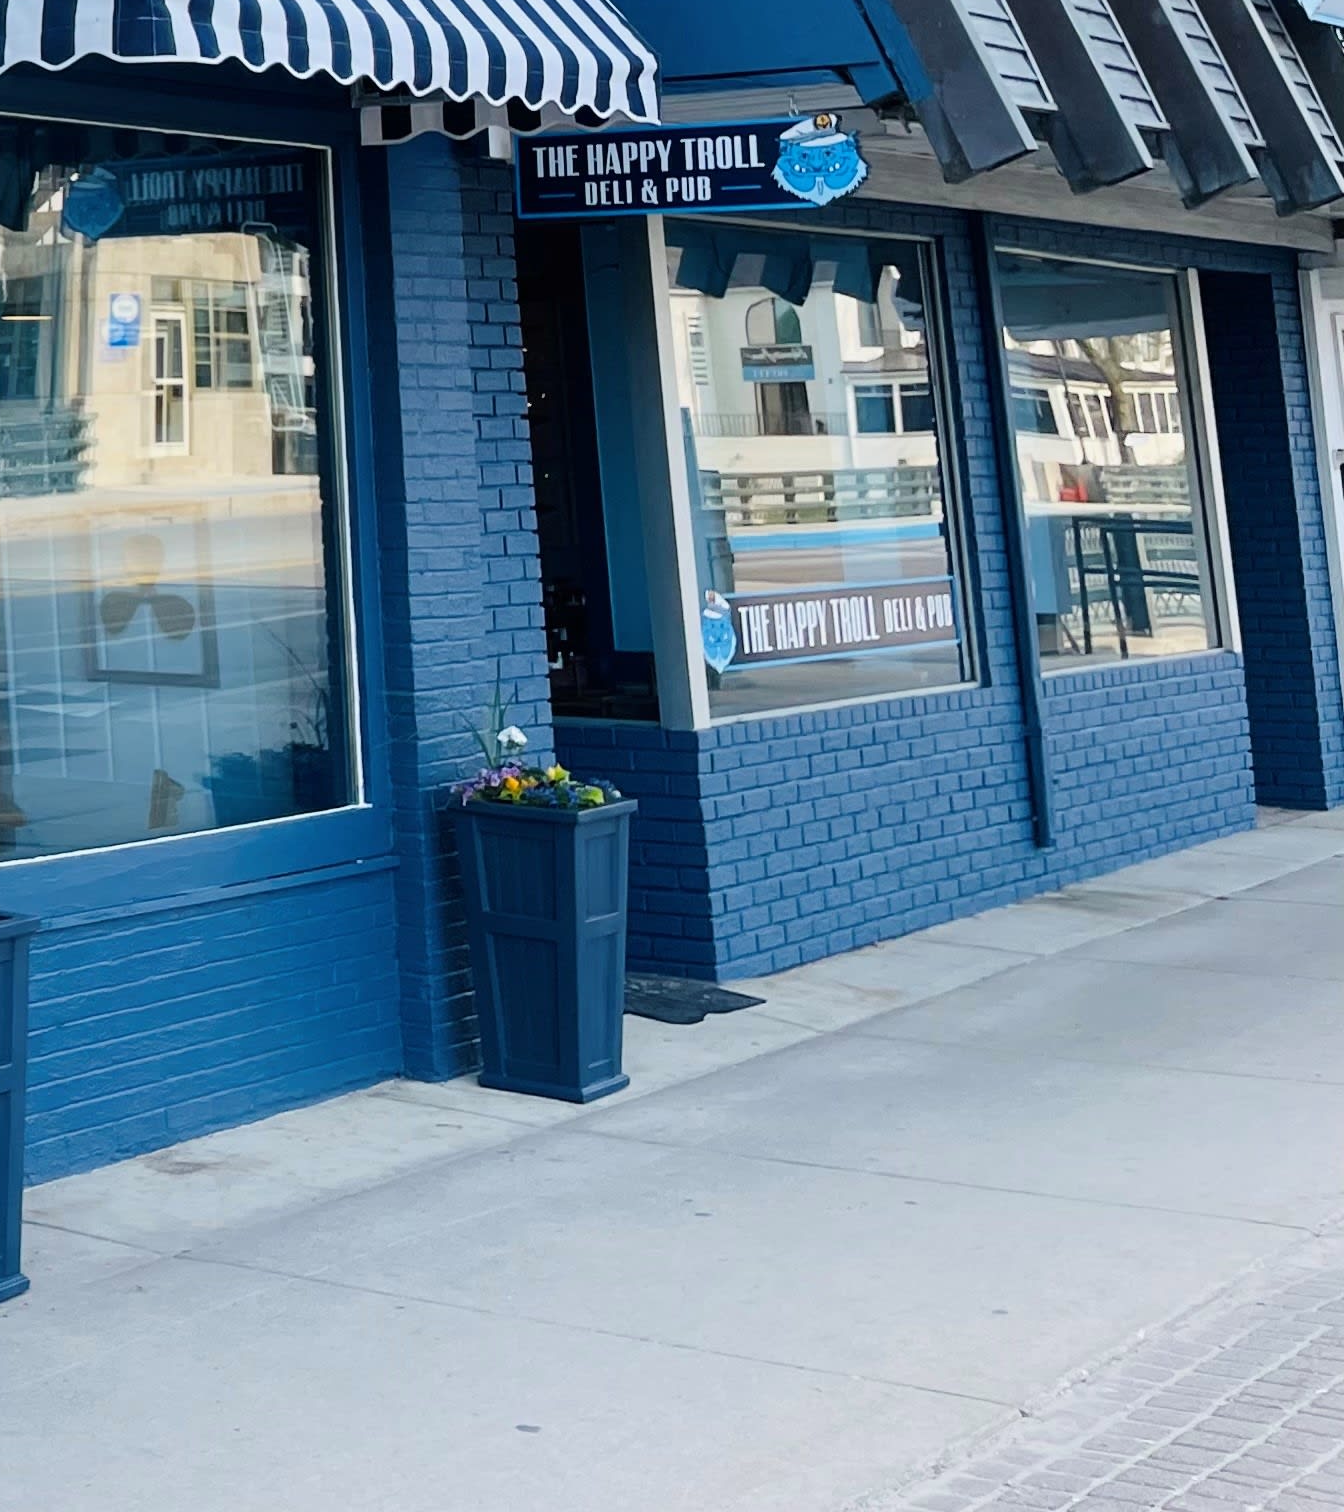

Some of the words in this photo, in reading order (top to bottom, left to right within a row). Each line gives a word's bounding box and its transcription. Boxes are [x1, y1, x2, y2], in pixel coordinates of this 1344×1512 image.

[532, 145, 579, 178] THE
[586, 139, 673, 176] HAPPY
[680, 135, 766, 171] TROLL
[585, 180, 633, 206] DELI
[641, 178, 659, 205] &
[666, 176, 712, 203] PUB
[738, 605, 773, 655] THE
[774, 598, 829, 651] HAPPY
[829, 595, 880, 643] TROLL
[883, 597, 913, 633] DELI
[914, 596, 927, 632] &
[927, 593, 953, 629] PUB
